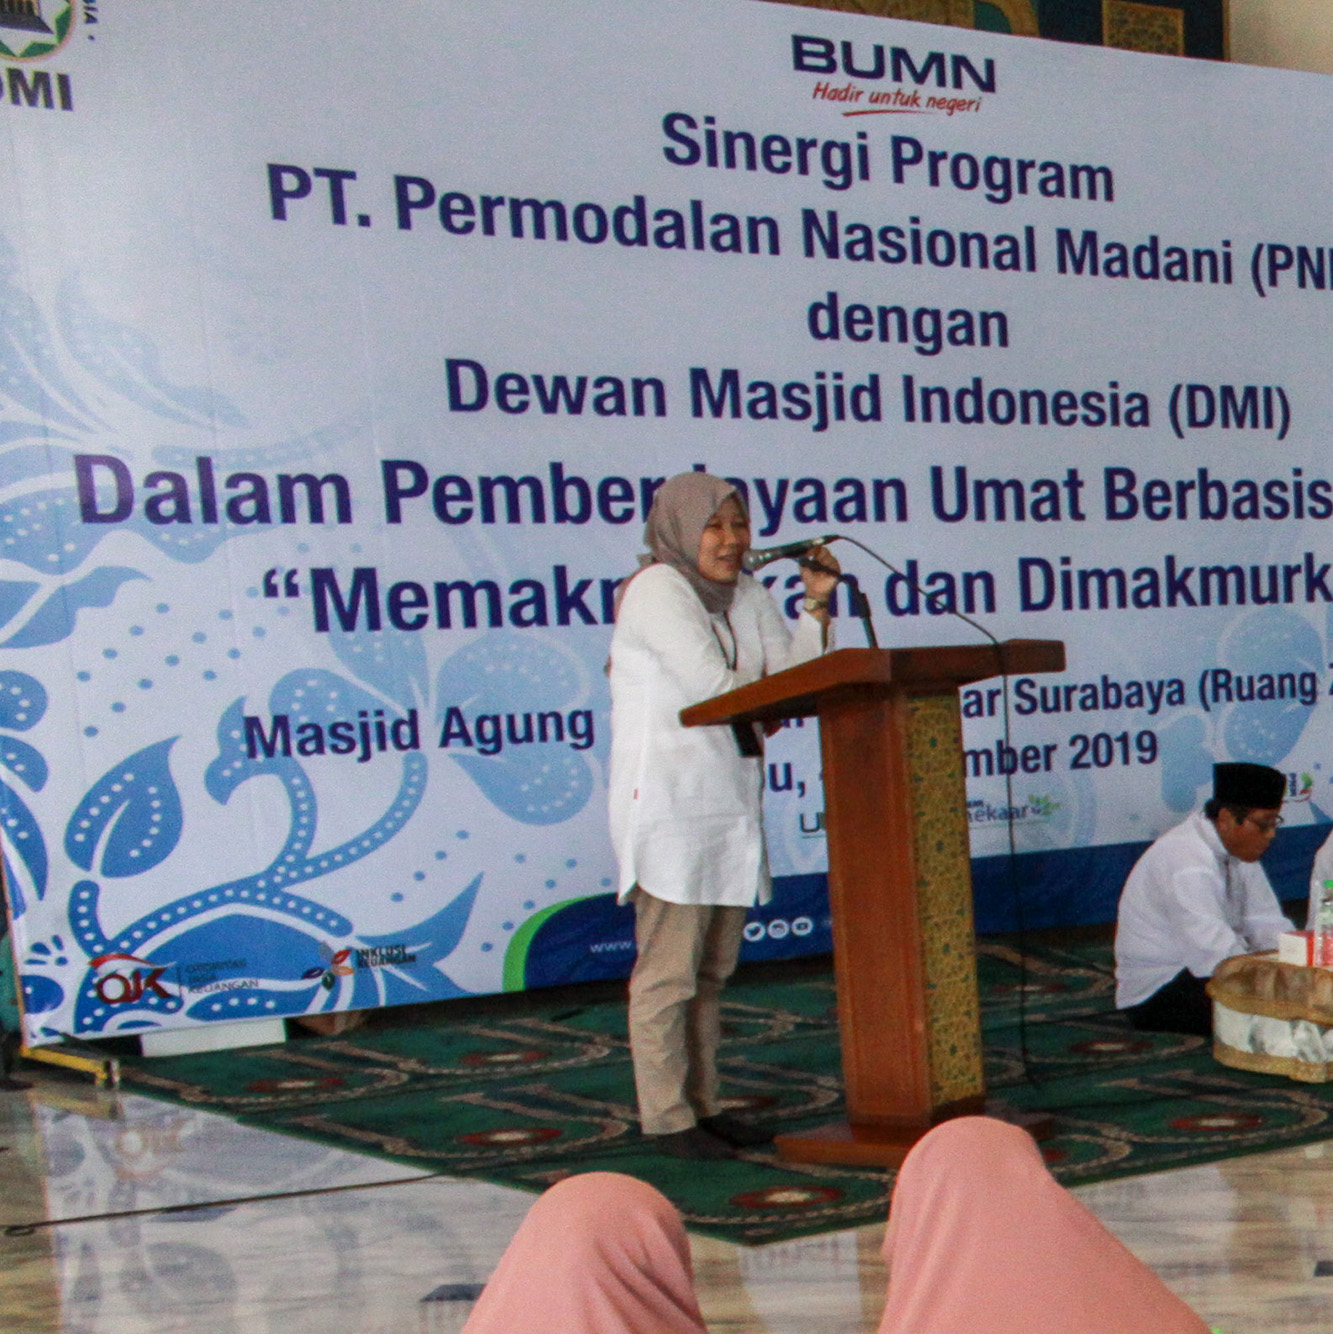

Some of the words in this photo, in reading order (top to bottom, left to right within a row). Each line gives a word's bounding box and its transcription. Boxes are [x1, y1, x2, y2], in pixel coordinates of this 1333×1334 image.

[0, 67, 73, 111] MI
[791, 34, 996, 93] BUMN
[812, 81, 864, 102] Hadir
[868, 89, 921, 108] untuk
[925, 97, 983, 116] negeri
[662, 111, 870, 190] Sinergi
[891, 135, 1114, 205] Program
[267, 163, 371, 228] PT.
[393, 174, 781, 256] Permodalan
[802, 208, 1037, 273] Nasional
[1056, 228, 1233, 285] Madani
[808, 291, 1009, 357] dengan
[446, 358, 667, 418] Dewan
[690, 367, 882, 433] Masjid
[902, 374, 1150, 428] Indonesia
[1169, 383, 1291, 441] (DMI)
[75, 455, 353, 525] Dalam
[381, 460, 908, 538] Pemberyaan
[931, 465, 1086, 523] Umat
[1104, 466, 1333, 522] Berbasis
[886, 558, 995, 618] dan
[1014, 674, 1186, 714] Surabaya
[1199, 668, 1318, 712] (Ruang
[244, 710, 420, 763] Masjid
[438, 706, 595, 754] Agung
[1069, 731, 1158, 768] 2019
